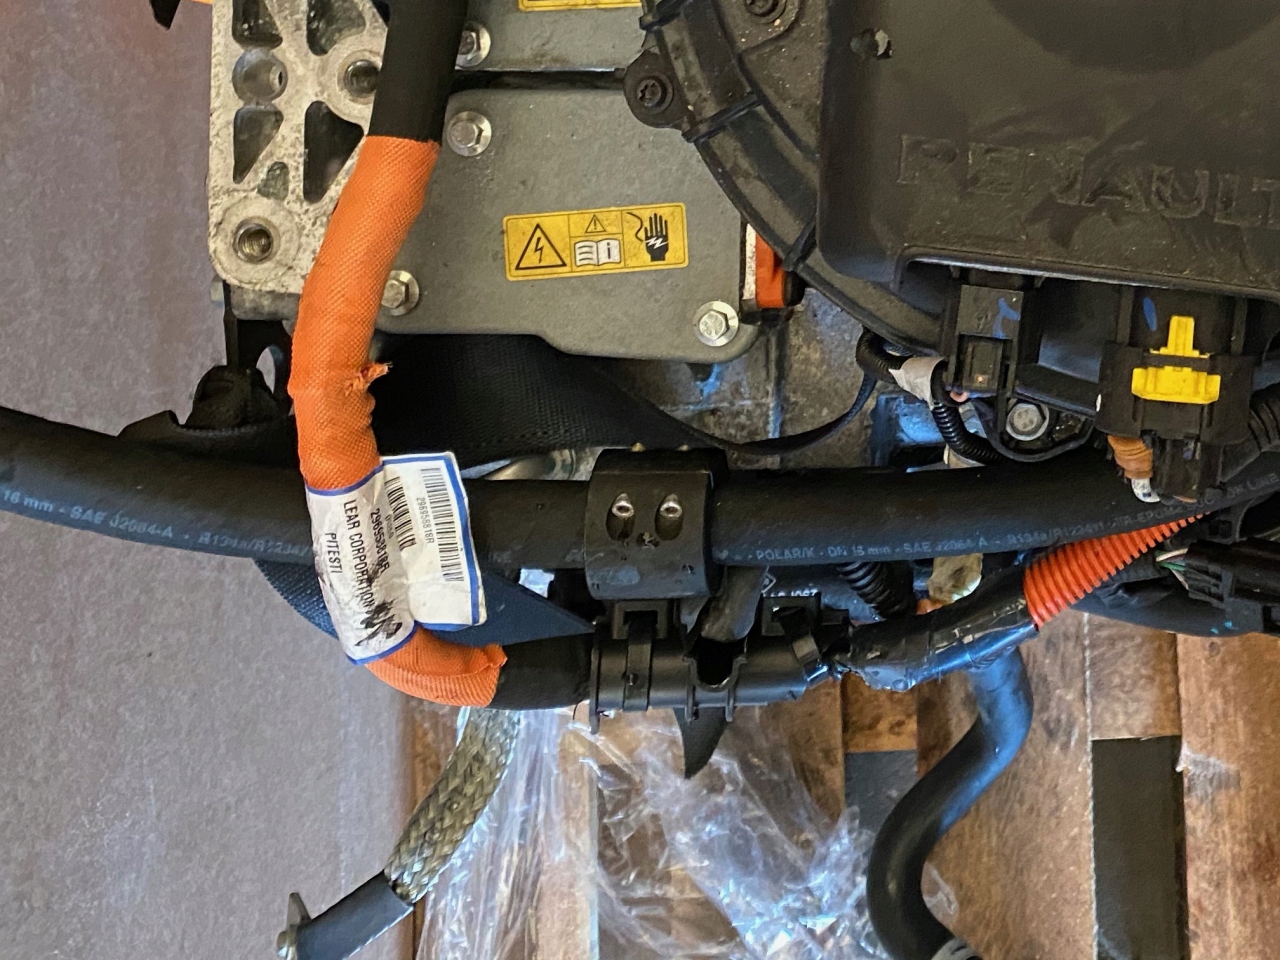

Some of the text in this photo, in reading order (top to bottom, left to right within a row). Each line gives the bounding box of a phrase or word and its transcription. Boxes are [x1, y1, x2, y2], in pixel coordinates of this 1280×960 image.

[23, 497, 54, 513] mm
[69, 505, 107, 526] SAE
[416, 497, 435, 544] 296958818R
[324, 532, 343, 574] PITESTI
[343, 499, 377, 614] LEAR CORPORATION
[867, 545, 891, 557] mm
[903, 542, 932, 554] SAE
